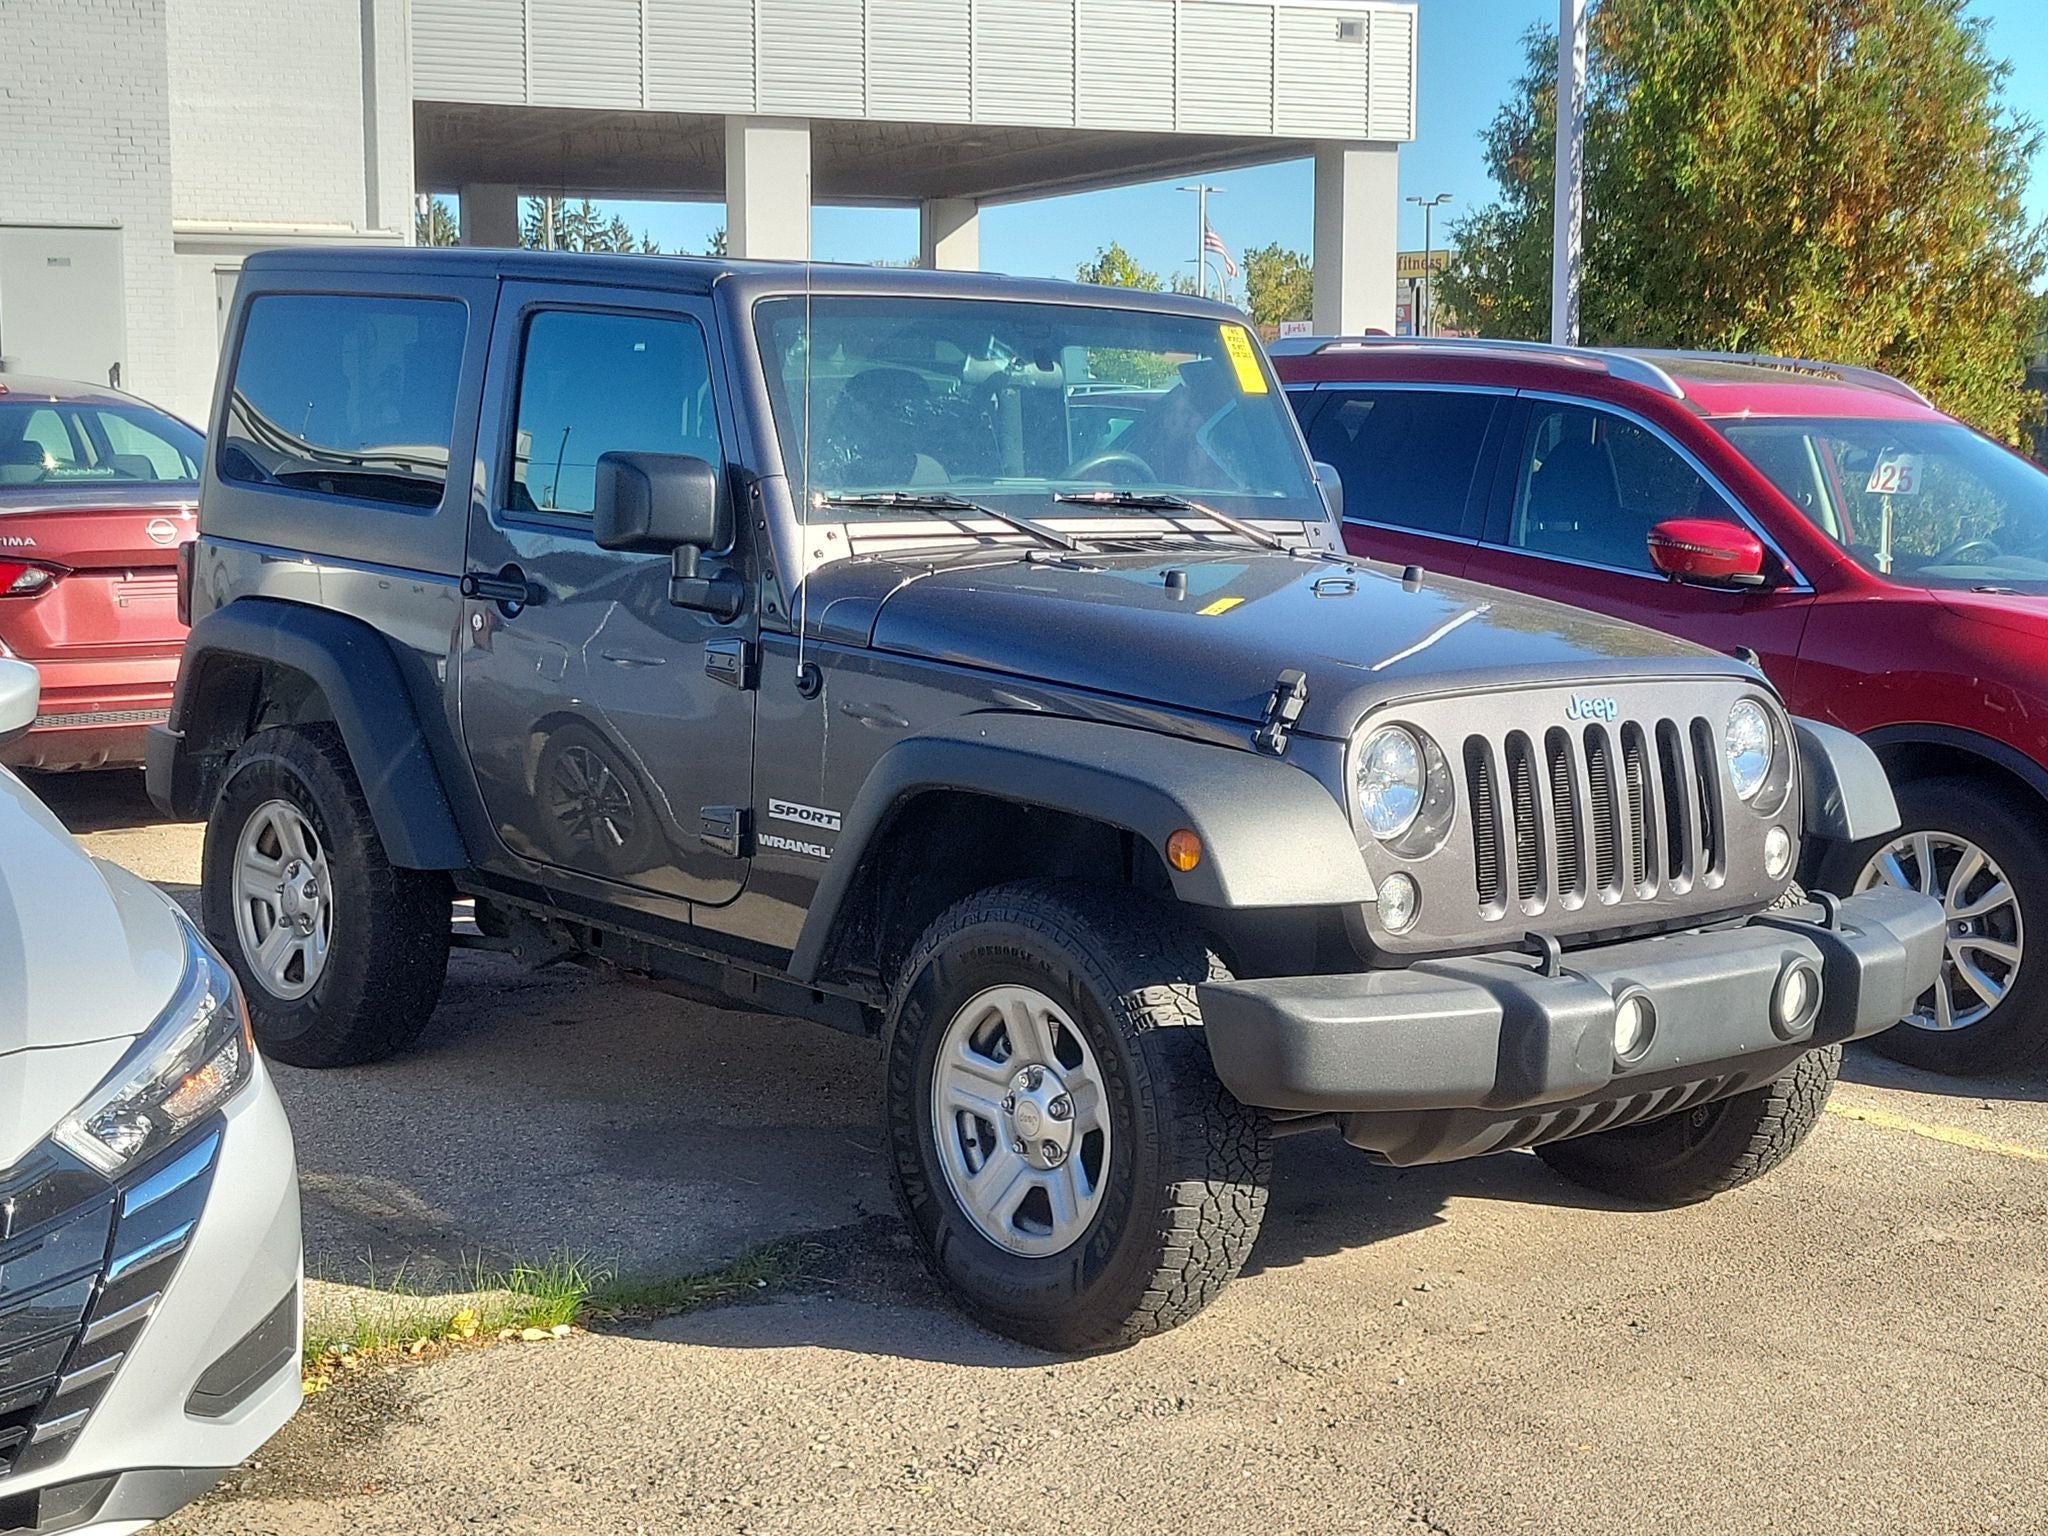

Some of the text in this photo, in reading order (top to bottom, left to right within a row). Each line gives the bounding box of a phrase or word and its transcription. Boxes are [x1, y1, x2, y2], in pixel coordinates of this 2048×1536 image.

[1397, 255, 1442, 270] fitness
[0, 537, 37, 546] IMA
[1565, 693, 1618, 722] Jeep
[770, 803, 841, 825] SPORT
[757, 832, 834, 859] WRANGL
